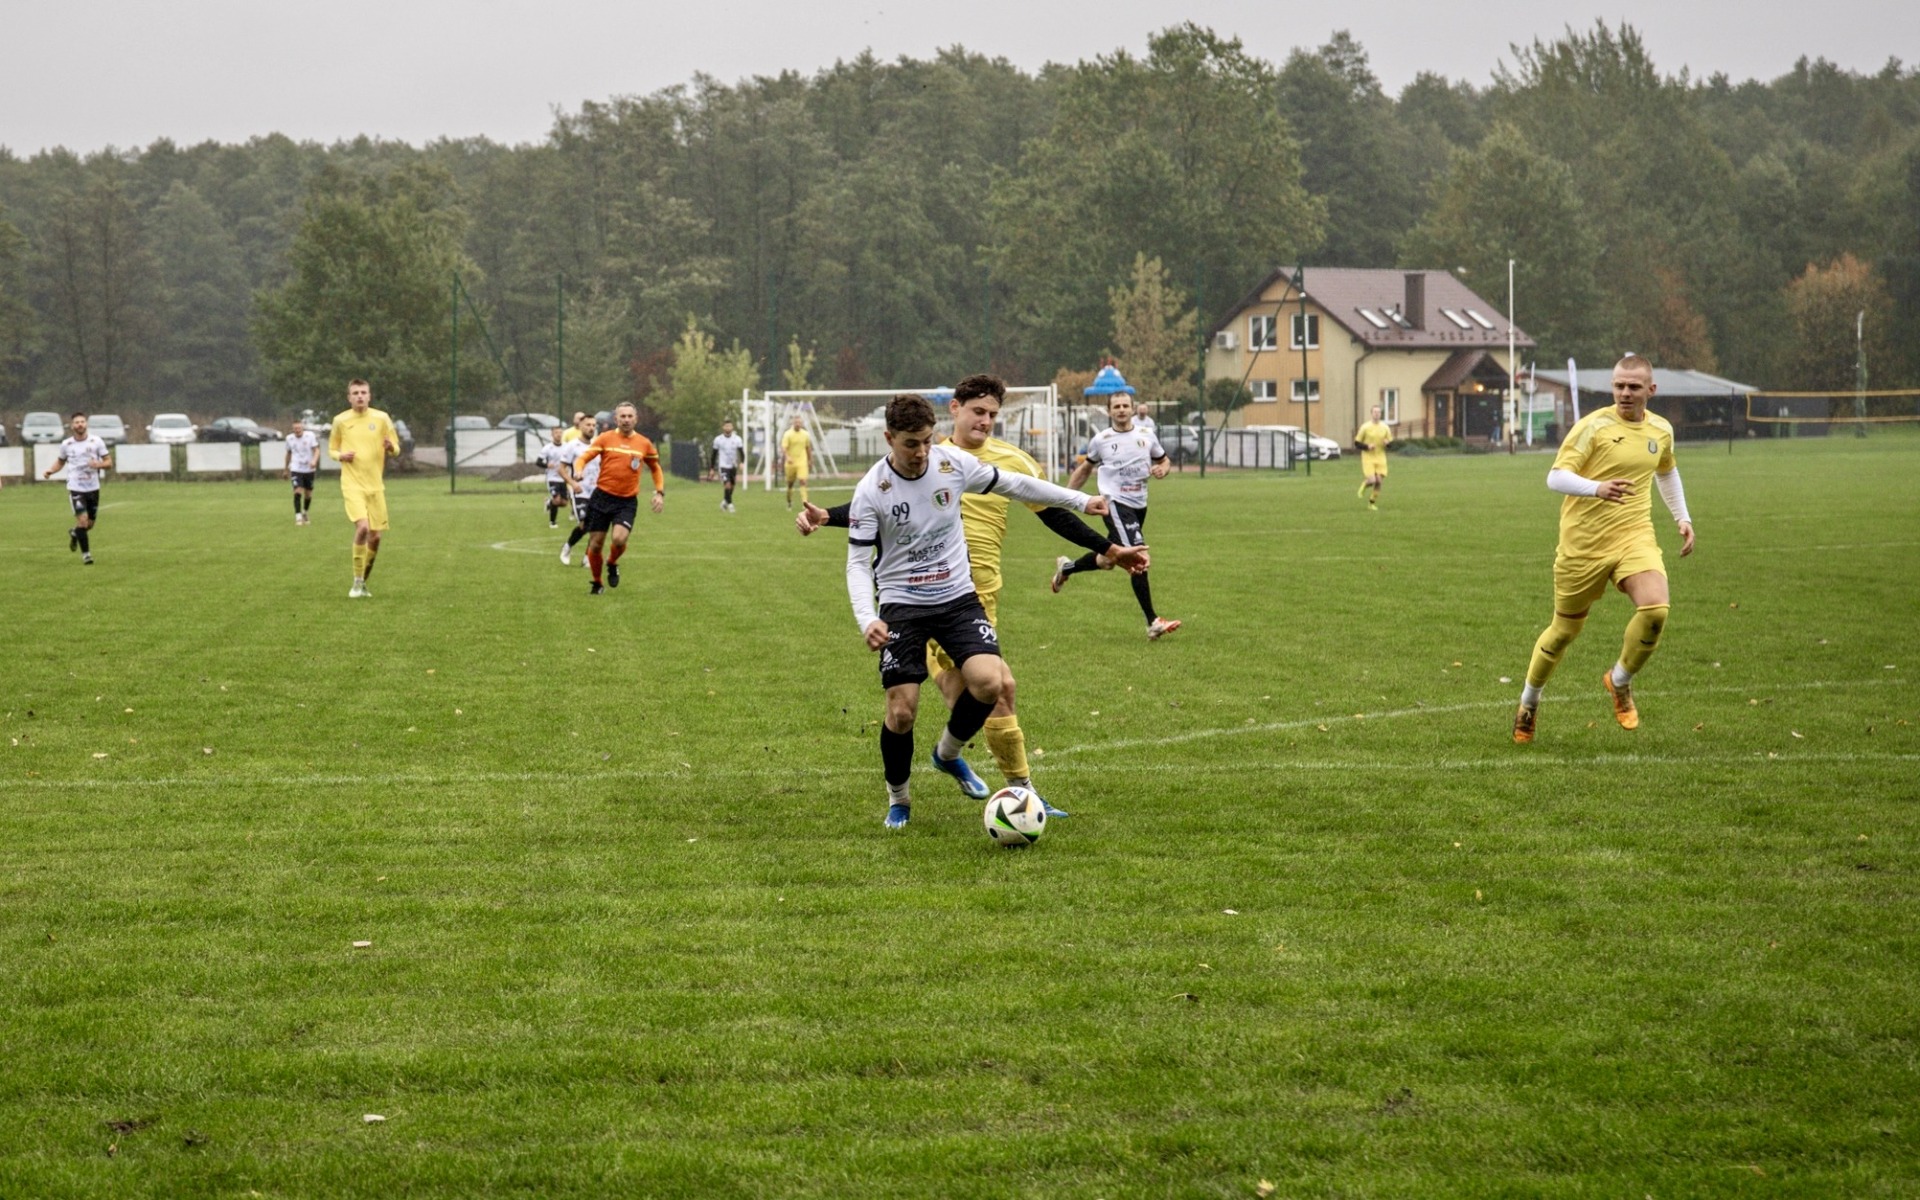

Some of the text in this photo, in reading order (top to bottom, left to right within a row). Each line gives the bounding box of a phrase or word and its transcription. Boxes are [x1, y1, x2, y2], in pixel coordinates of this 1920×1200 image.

[1111, 443, 1118, 452] 9
[892, 502, 910, 522] 99
[908, 542, 945, 556] MASTER
[979, 625, 998, 641] 99
